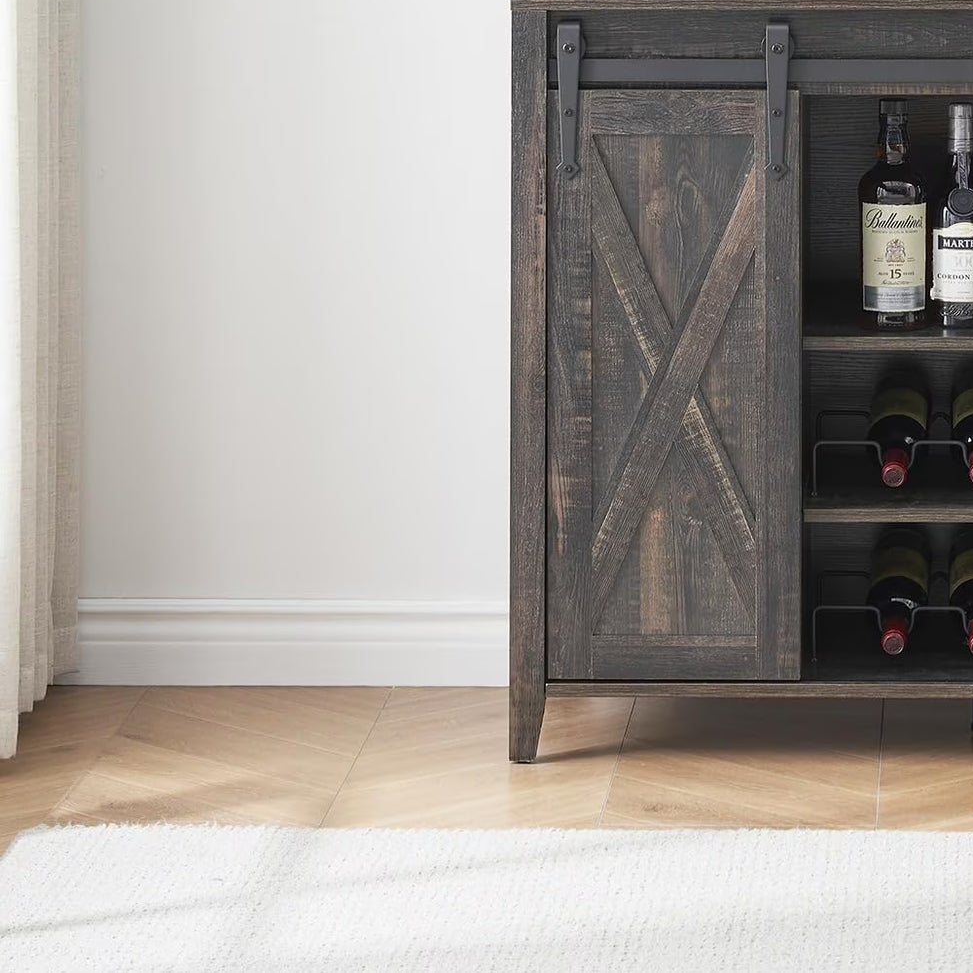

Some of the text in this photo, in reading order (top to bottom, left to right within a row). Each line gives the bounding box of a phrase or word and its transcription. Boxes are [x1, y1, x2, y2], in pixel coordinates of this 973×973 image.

[865, 207, 924, 229] Ballantine's
[889, 268, 903, 279] 15
[937, 272, 971, 280] CORDON
